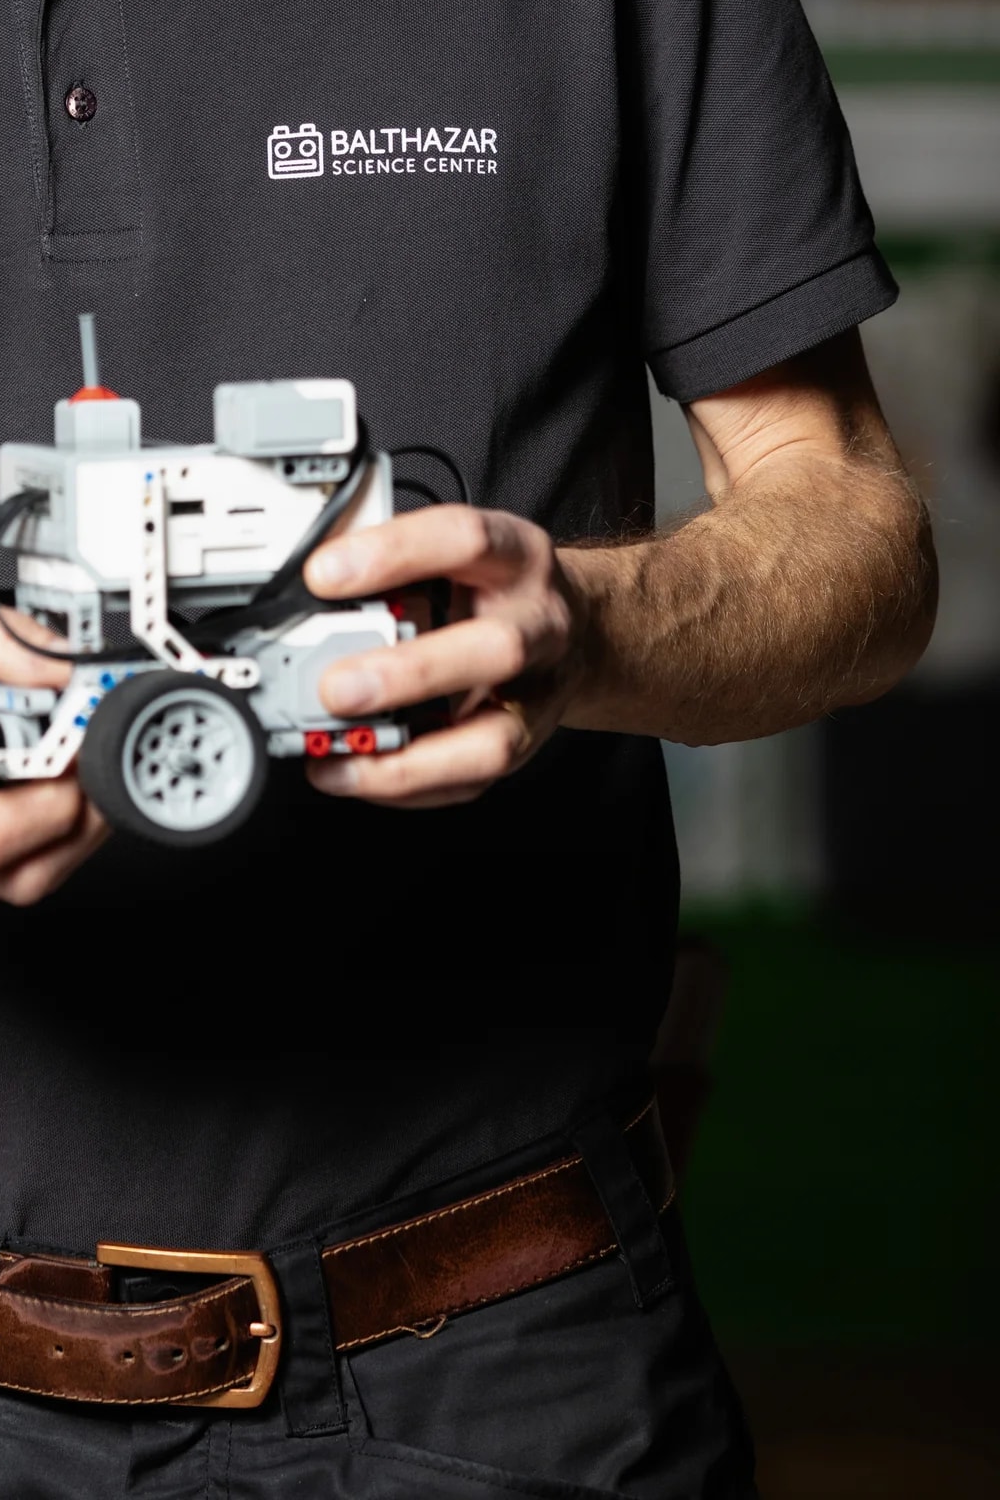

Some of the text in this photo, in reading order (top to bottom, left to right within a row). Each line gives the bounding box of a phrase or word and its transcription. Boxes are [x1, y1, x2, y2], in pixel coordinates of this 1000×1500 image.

[331, 127, 498, 155] BALTHAZAR
[331, 157, 498, 175] SCIENCE CENTER
